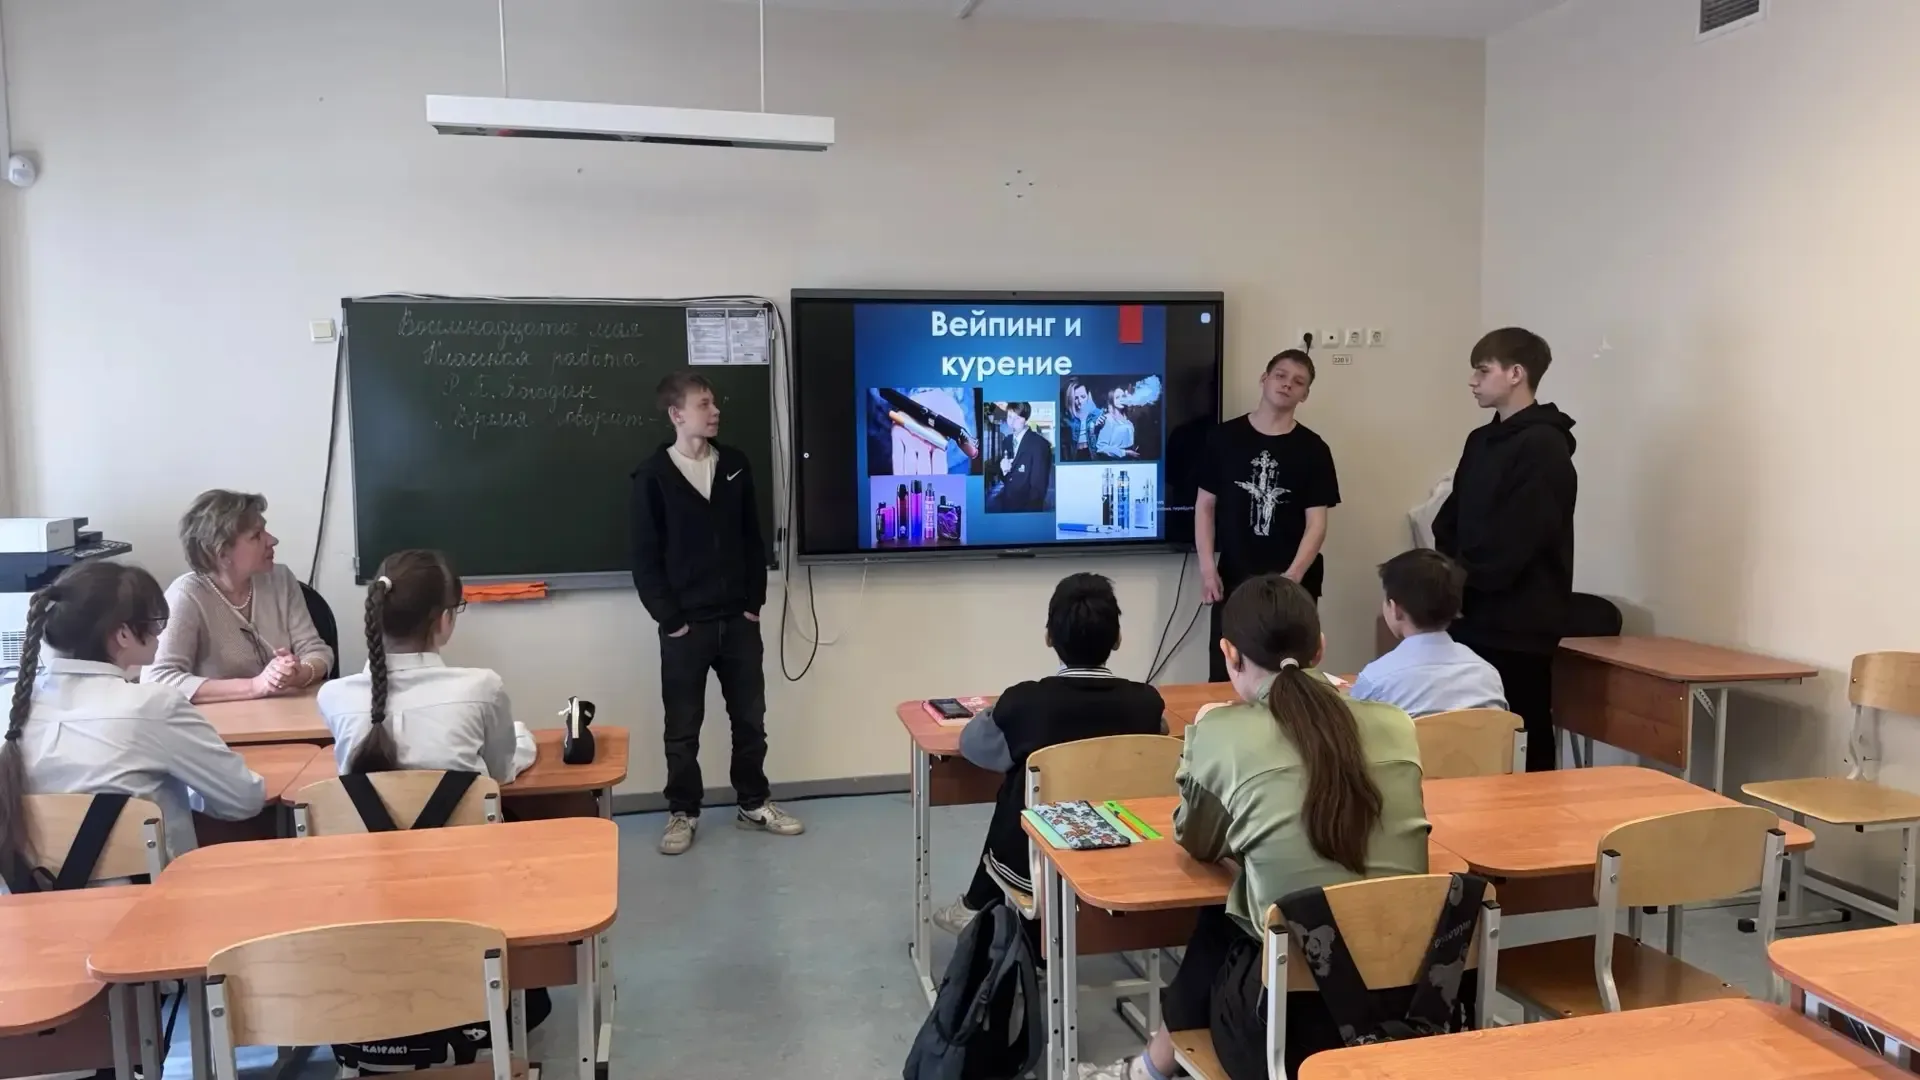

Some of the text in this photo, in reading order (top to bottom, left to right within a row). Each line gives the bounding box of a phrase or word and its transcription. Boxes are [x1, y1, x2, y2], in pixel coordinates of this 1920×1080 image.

[589, 320, 644, 338] мая
[931, 310, 1081, 337] Вейпинг и
[550, 343, 644, 376] работа
[942, 355, 1073, 382] курение
